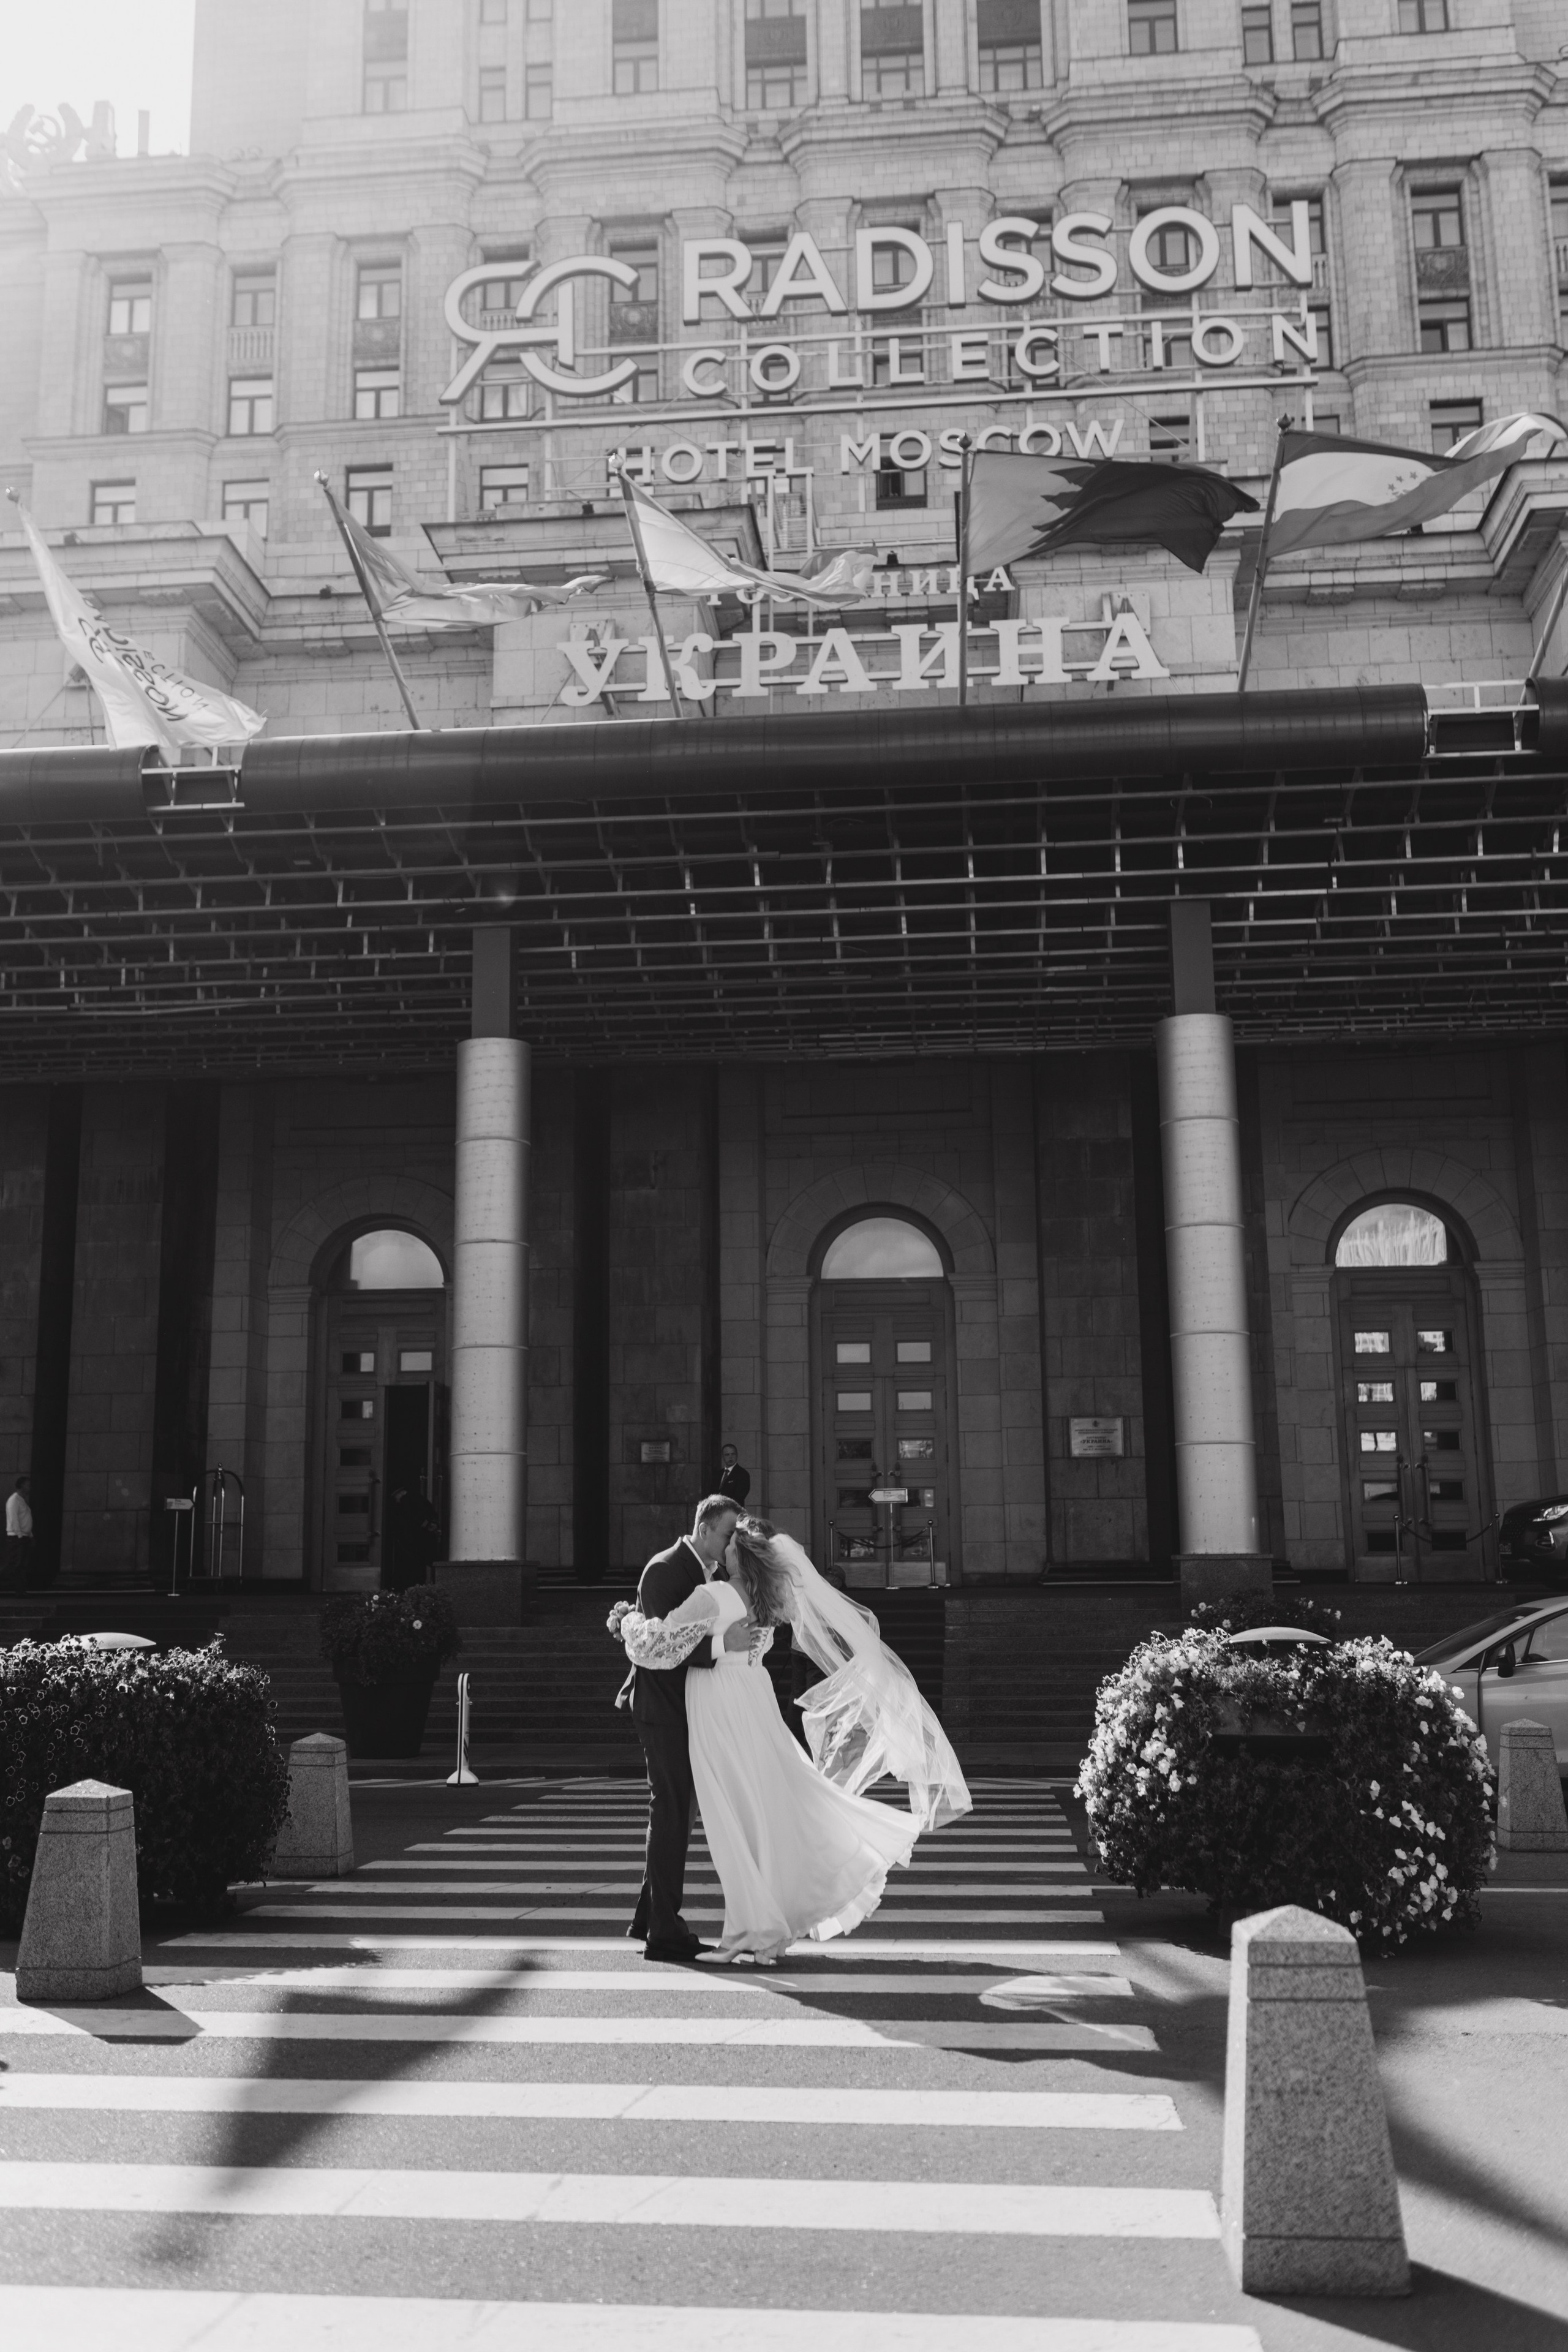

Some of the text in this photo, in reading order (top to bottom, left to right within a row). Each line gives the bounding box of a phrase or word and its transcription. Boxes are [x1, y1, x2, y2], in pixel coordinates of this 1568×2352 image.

[683, 200, 1313, 325] RADISSON
[682, 313, 1318, 397] COLLECTION
[617, 419, 1125, 483] HOTEL MOSCOW
[556, 611, 1169, 707] УКРАИНА
